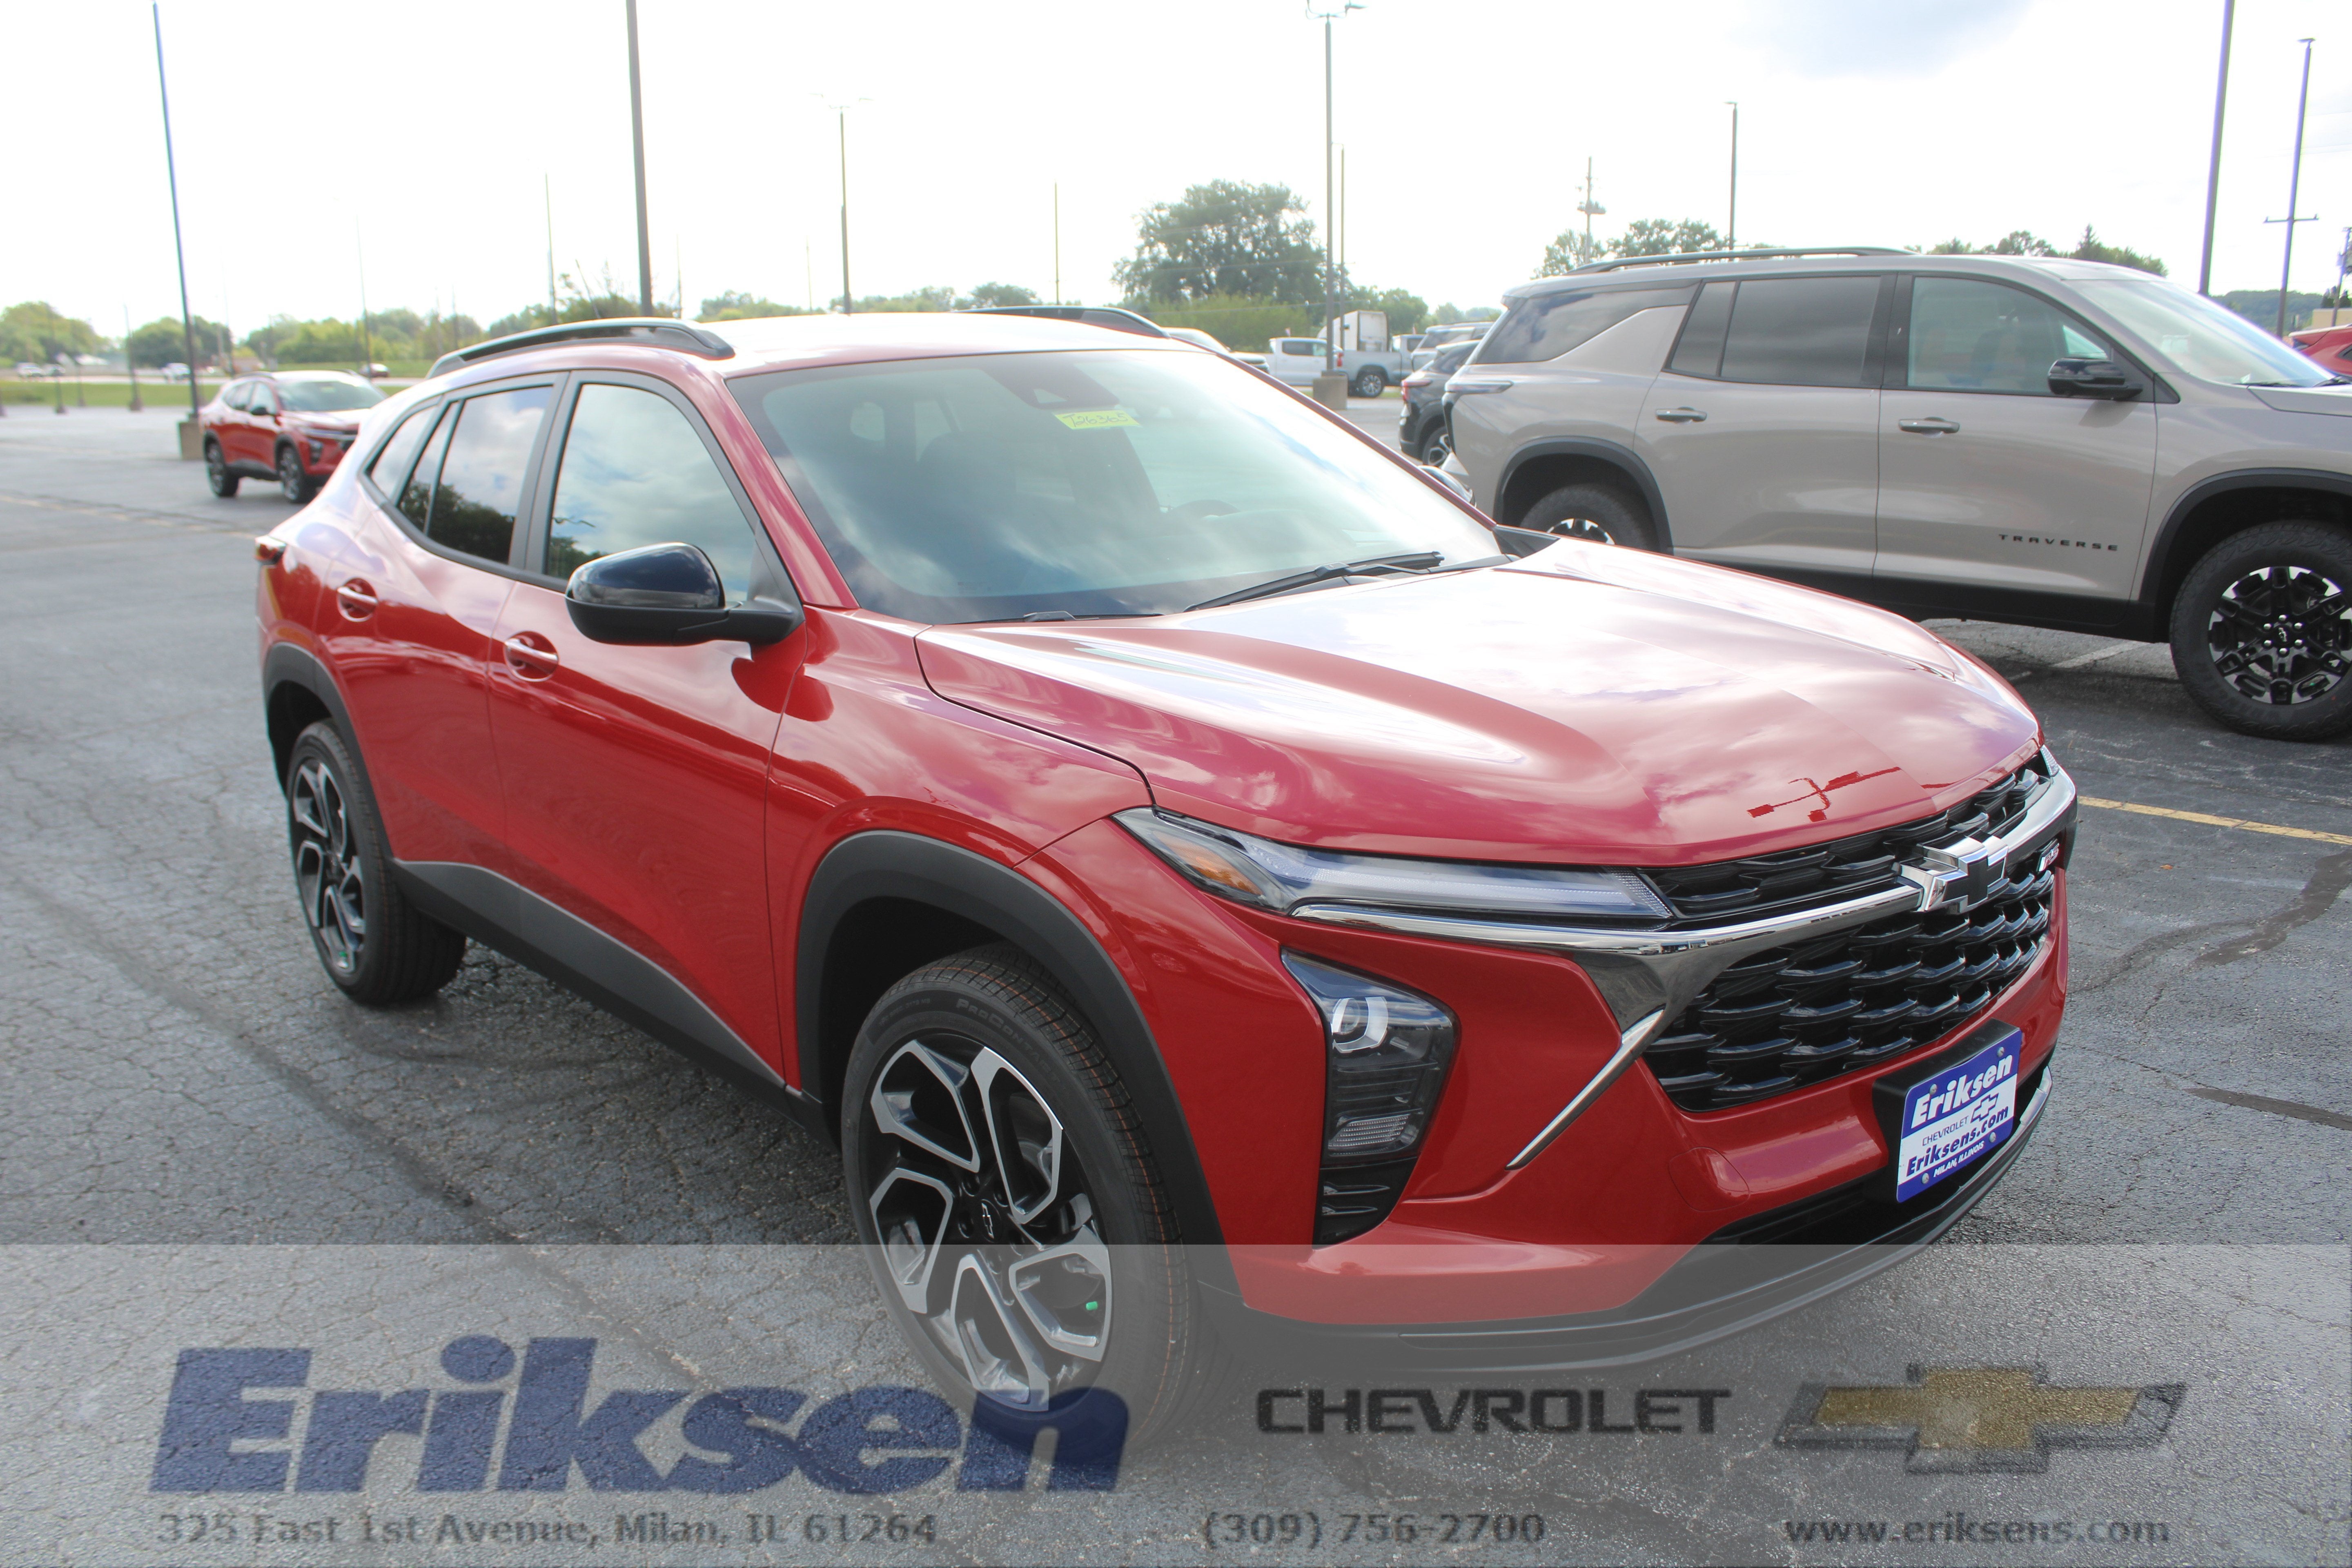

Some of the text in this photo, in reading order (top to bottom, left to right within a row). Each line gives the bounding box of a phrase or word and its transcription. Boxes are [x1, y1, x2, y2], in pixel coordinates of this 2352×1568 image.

[1998, 534, 2118, 551] TRAVERSE
[2038, 842, 2060, 872] RS
[1911, 1054, 2013, 1129] Eriksen
[1906, 1105, 2008, 1177] Eriksens.com
[1922, 1115, 1969, 1147] CHEVROLET
[1933, 1140, 1984, 1177] MILAN, ILLINOIS
